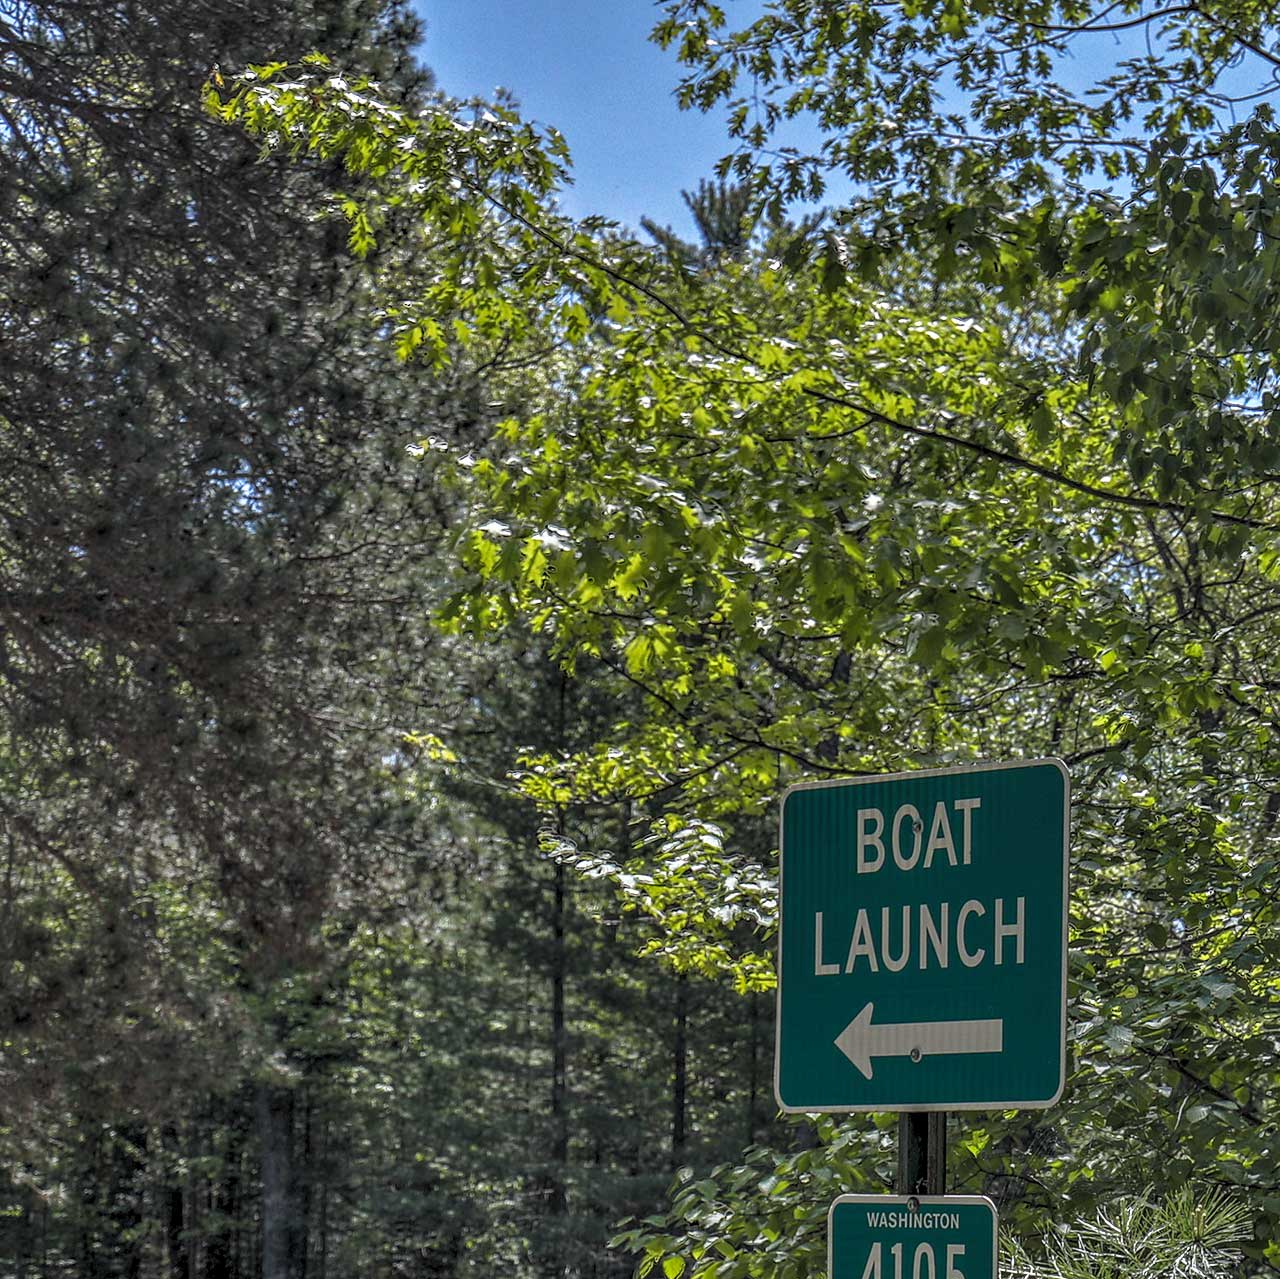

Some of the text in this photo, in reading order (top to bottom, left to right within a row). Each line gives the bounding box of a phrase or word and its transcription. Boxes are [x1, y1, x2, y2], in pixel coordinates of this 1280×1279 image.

[857, 798, 981, 874] BOAT
[814, 897, 1026, 976] LAUNCH
[867, 1212, 960, 1229] WASHINGTON
